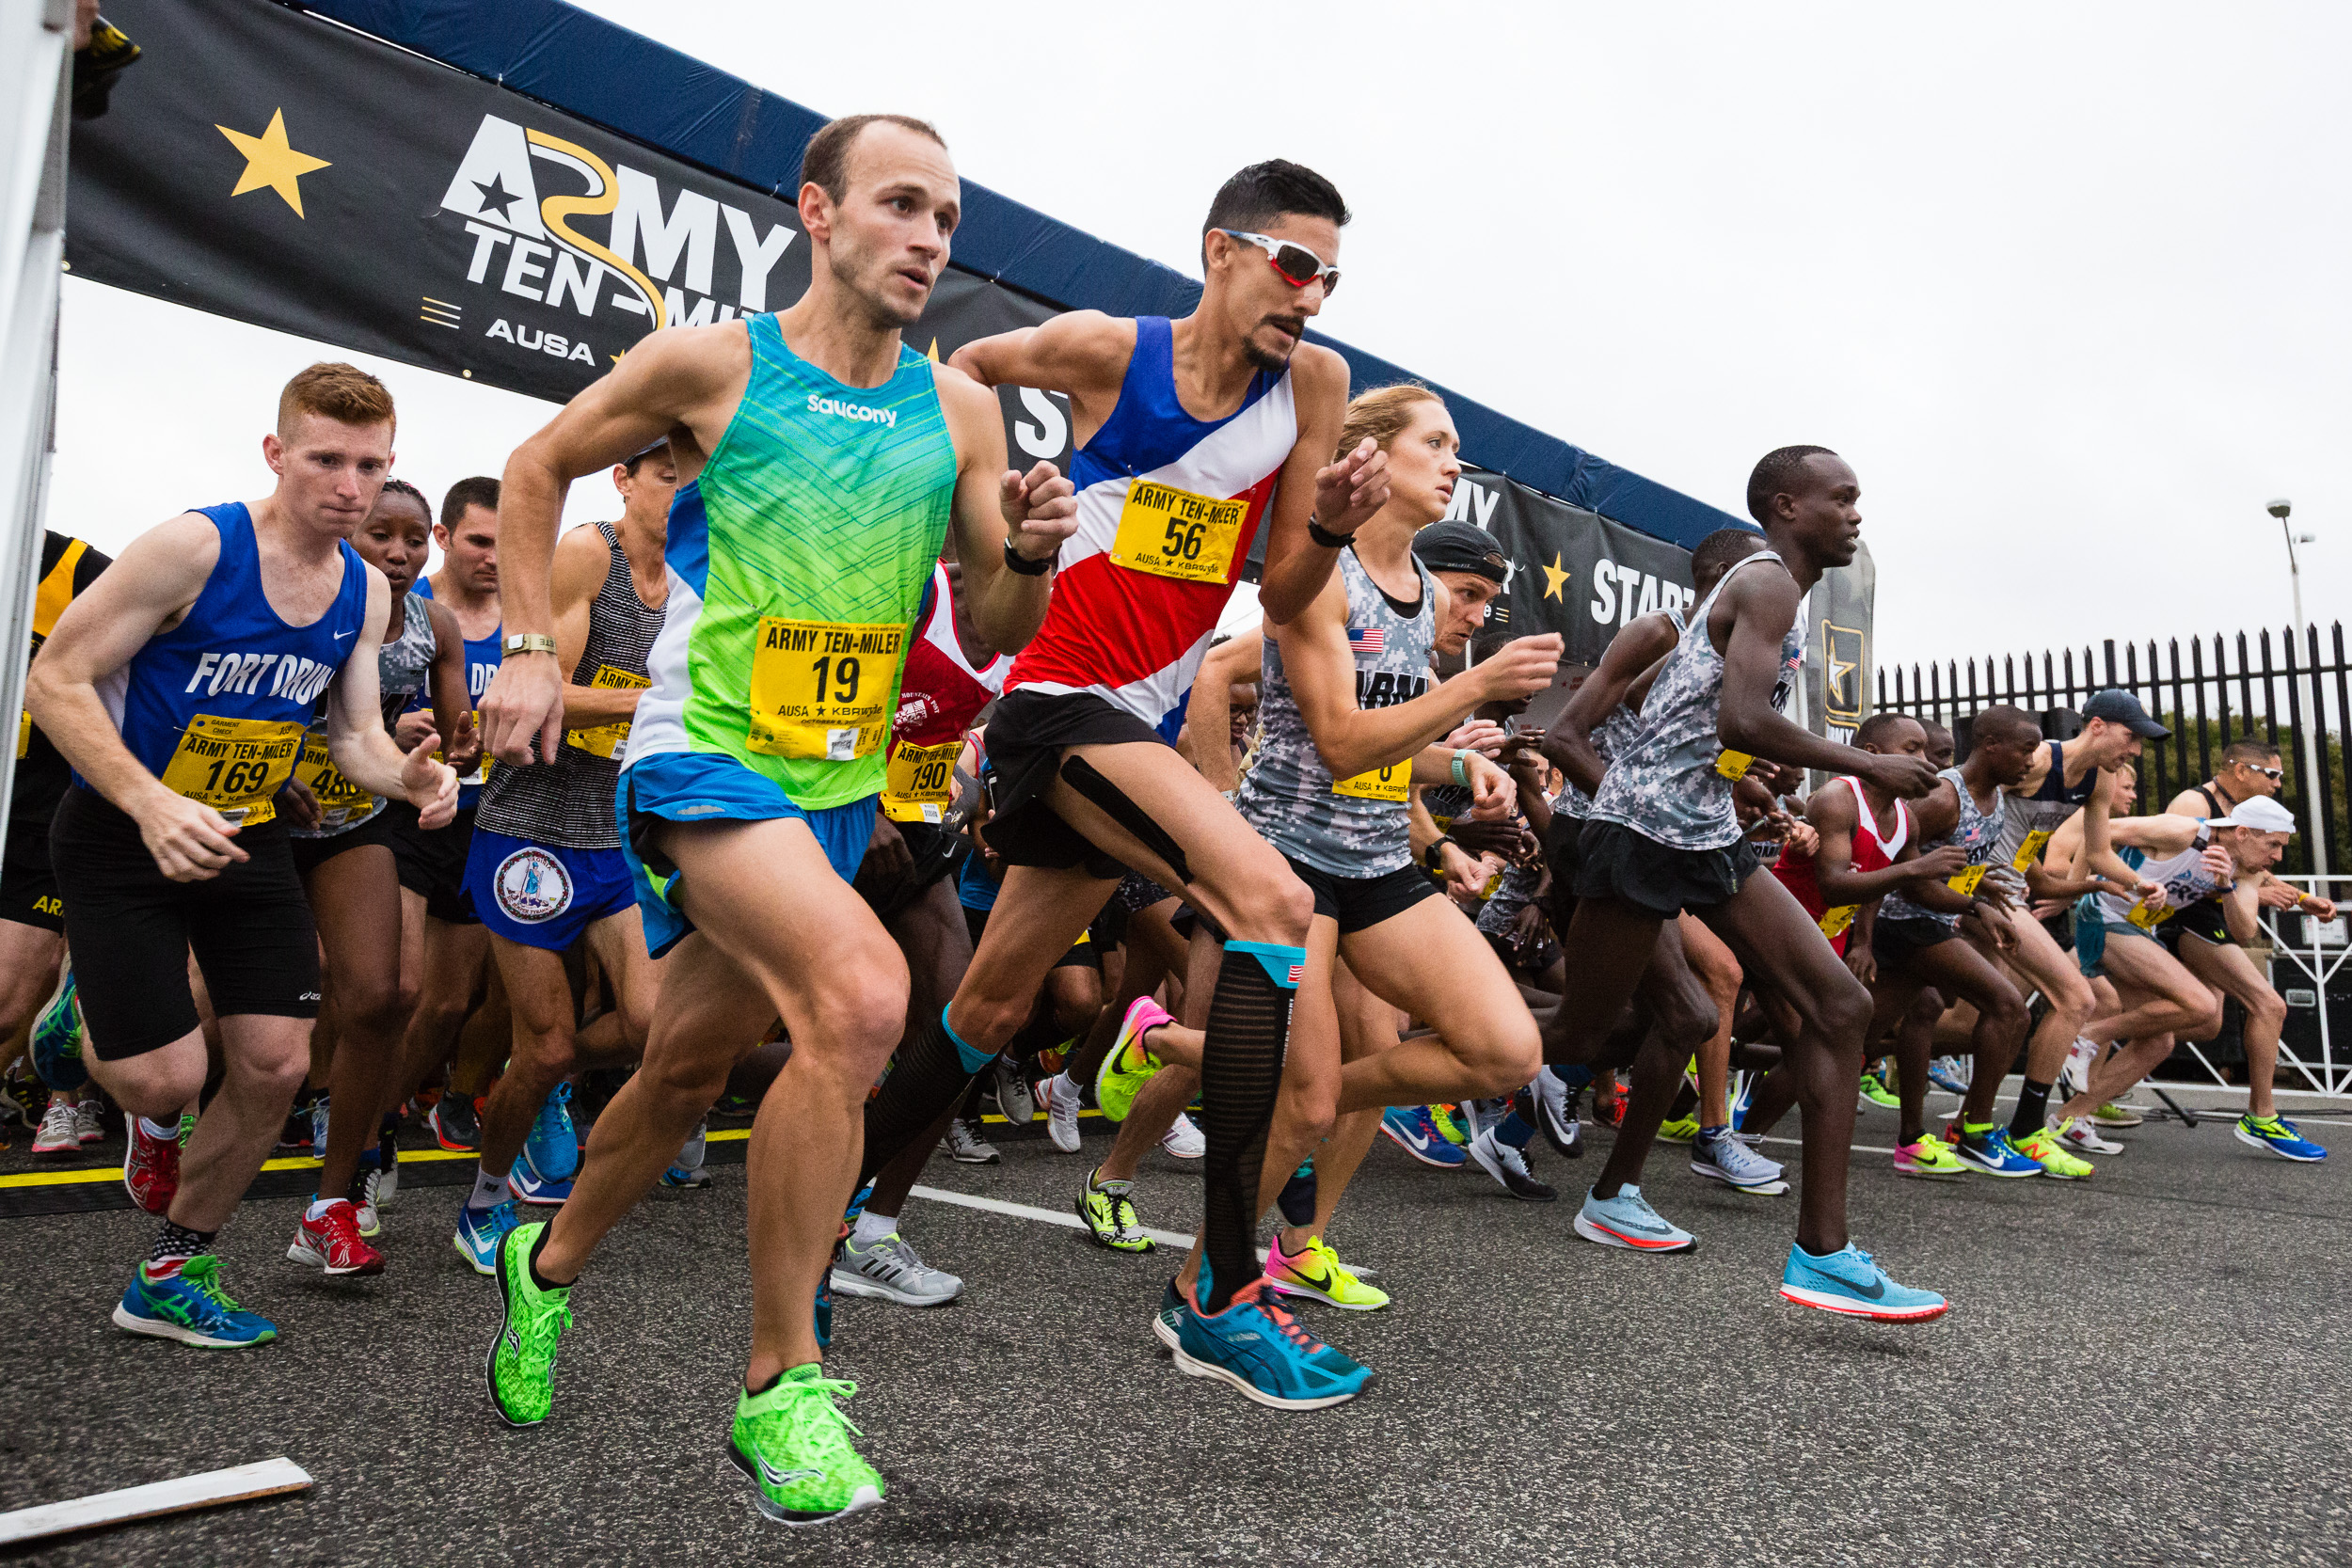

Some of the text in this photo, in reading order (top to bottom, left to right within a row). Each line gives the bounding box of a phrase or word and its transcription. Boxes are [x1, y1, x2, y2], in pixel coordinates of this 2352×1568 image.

[440, 114, 798, 311] ARMY
[485, 318, 596, 367] AUSA
[807, 394, 898, 428] saucony
[1132, 485, 1177, 513] ARMY
[1179, 499, 1240, 526] TEN-MILER
[1162, 516, 1206, 560] 56
[1135, 552, 1160, 566] AUSA
[765, 626, 900, 655] ARMY TEN-MILER
[185, 652, 278, 697] FORT
[598, 672, 631, 689] ARMY
[812, 656, 860, 704] 19
[211, 719, 240, 728] GARMENT
[777, 704, 882, 717] AUSA KBRwyle
[213, 727, 232, 736] CHECK
[184, 737, 230, 758] ARMY
[232, 742, 294, 760] TEN-MILER
[205, 759, 269, 793] 169
[911, 762, 946, 791] 190
[1354, 782, 1372, 791] AUSA
[183, 790, 209, 800] AUSA
[32, 895, 66, 918] AR
